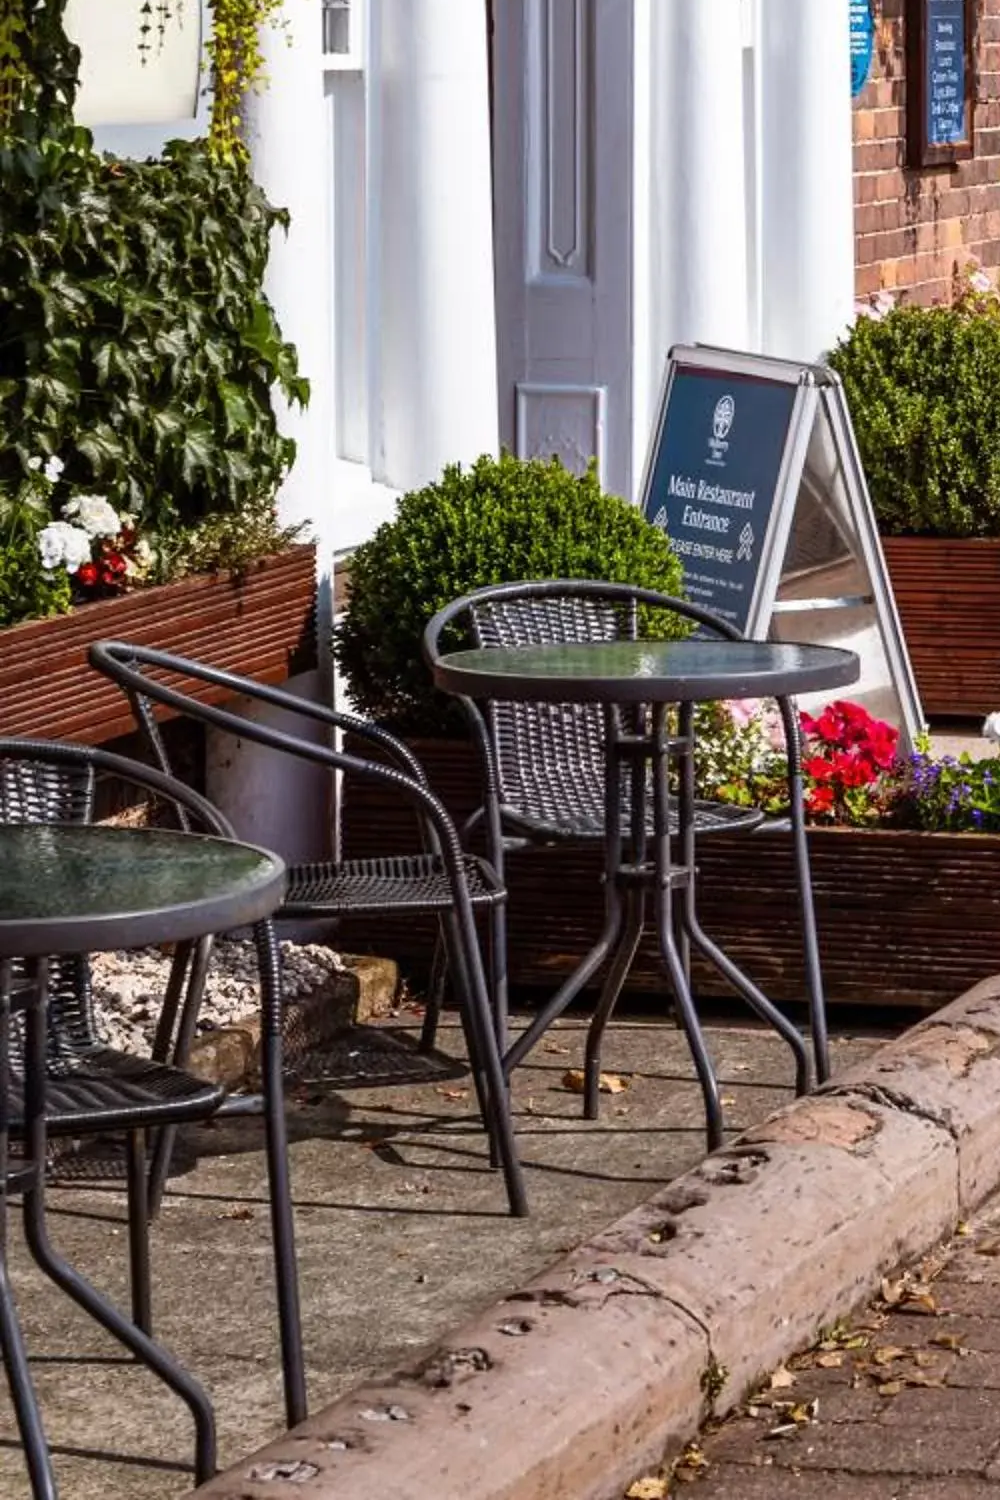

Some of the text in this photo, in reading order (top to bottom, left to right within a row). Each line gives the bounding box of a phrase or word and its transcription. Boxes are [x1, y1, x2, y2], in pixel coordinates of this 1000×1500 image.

[667, 474, 756, 510] Main Restaurant
[681, 504, 731, 533] Entrance
